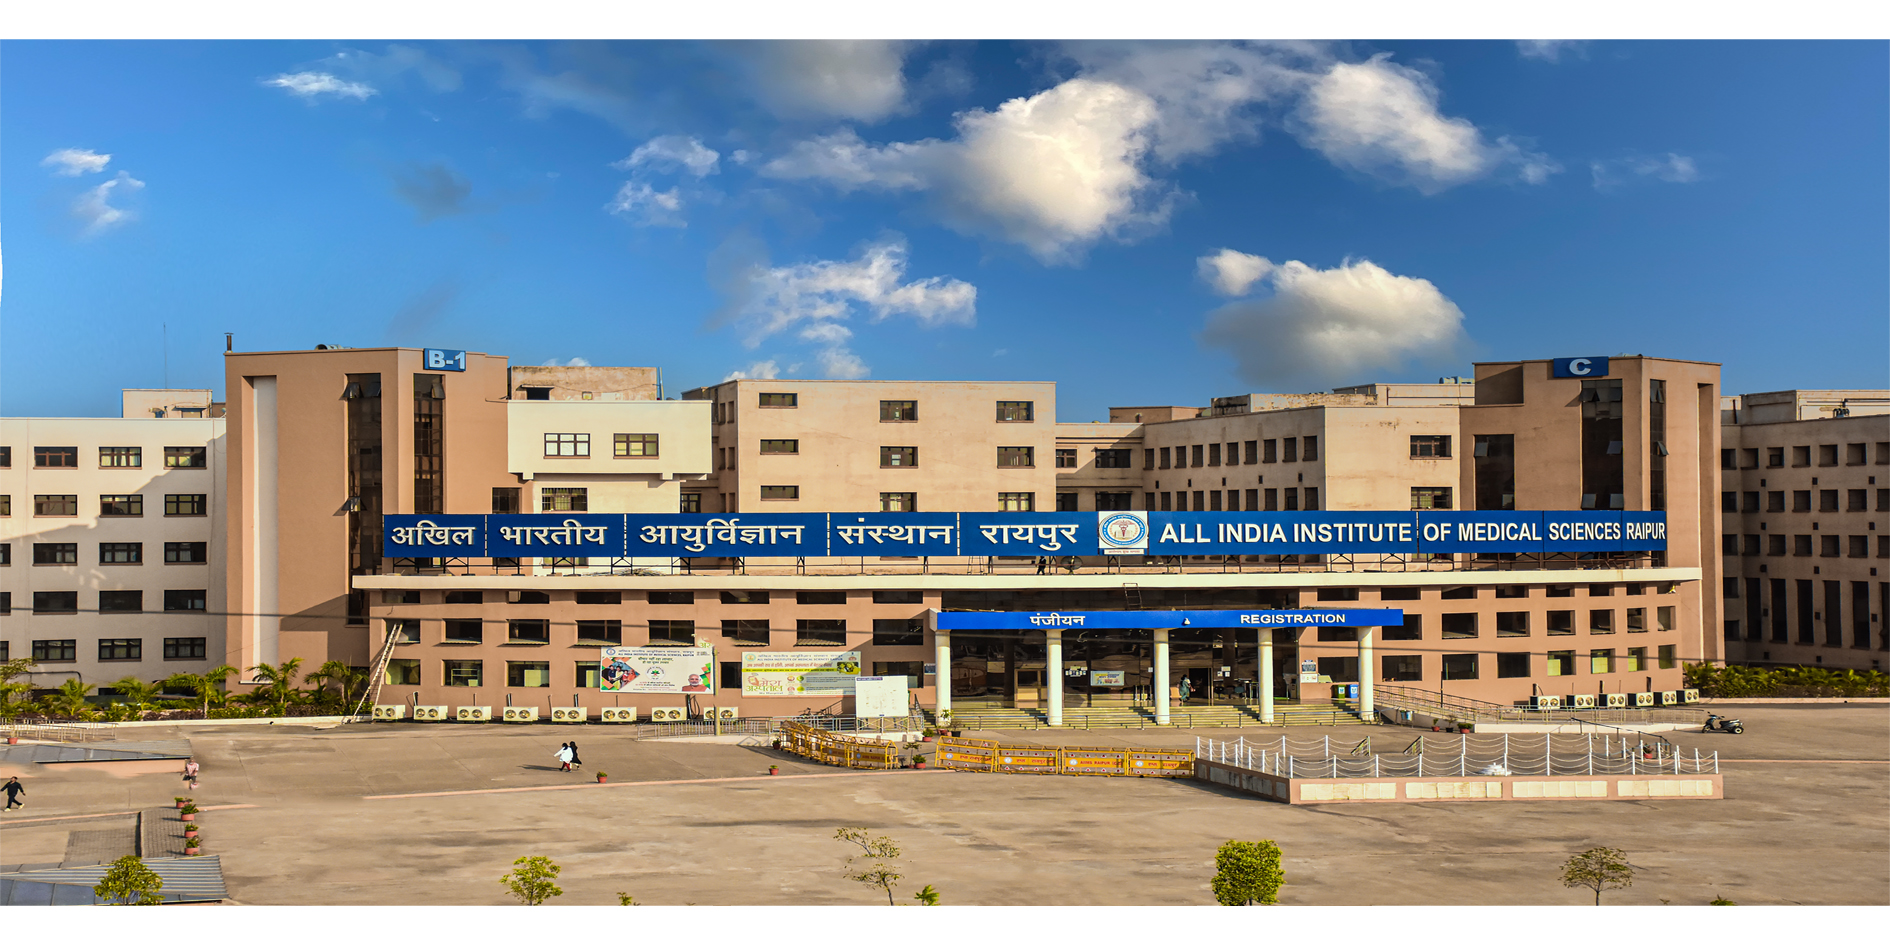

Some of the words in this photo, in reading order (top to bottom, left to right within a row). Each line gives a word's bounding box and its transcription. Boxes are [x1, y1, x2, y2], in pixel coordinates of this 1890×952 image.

[428, 350, 465, 369] B-1
[1569, 358, 1592, 375] C
[391, 519, 476, 546] अखिल
[499, 518, 608, 545] भारतीय
[639, 518, 806, 552] आयुर्विज्ञान
[836, 517, 954, 545] संस्थान
[979, 524, 1080, 551] रायपुर
[1159, 523, 1211, 544] ALL
[1218, 523, 1288, 543] INDIA
[1293, 523, 1413, 543] INSTITUTE
[1423, 522, 1452, 542] OF
[1458, 522, 1543, 541] MEDICAL
[1549, 522, 1622, 541] SCIENCES
[1626, 522, 1666, 540] RAIPUR
[1029, 612, 1086, 627] पंजीयन
[1240, 613, 1346, 625] REGISTRATION
